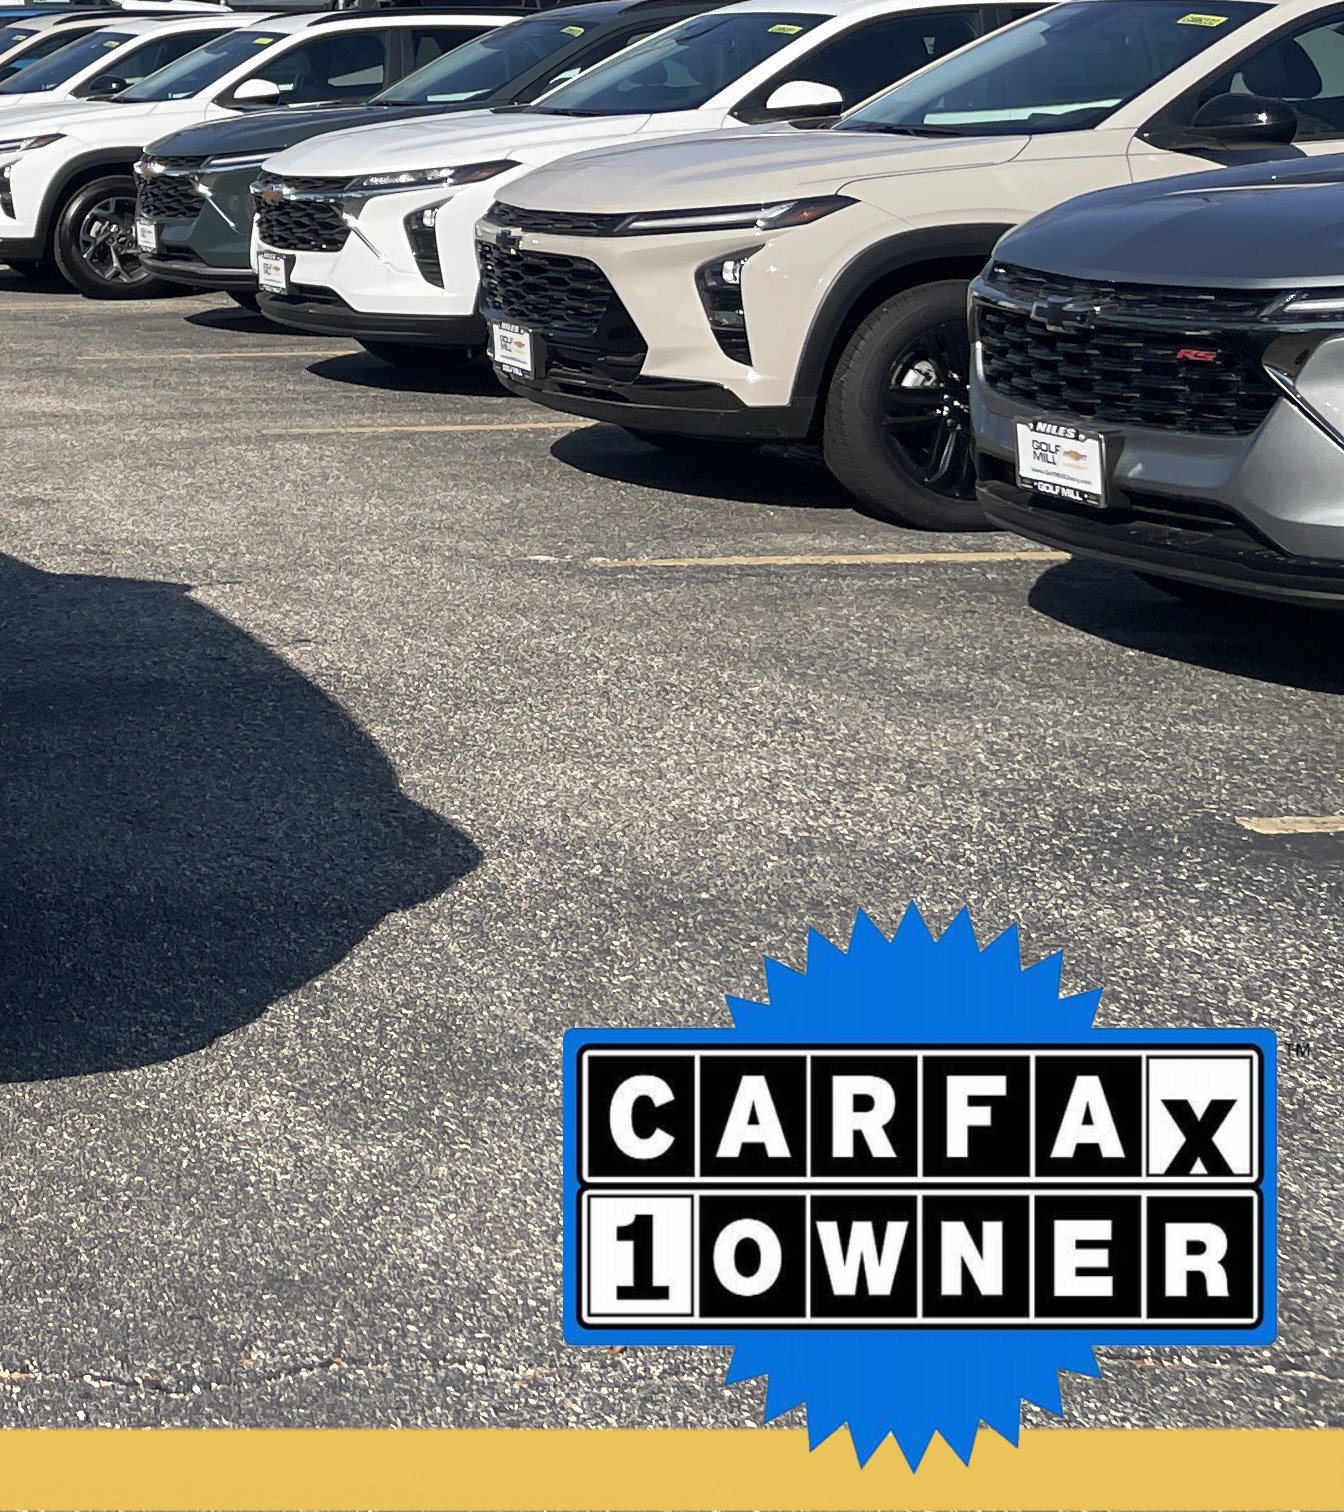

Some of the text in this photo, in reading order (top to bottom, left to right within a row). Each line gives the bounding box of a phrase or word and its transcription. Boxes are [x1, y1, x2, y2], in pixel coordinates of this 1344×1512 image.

[1176, 348, 1216, 361] RS
[1035, 421, 1077, 439] NILES
[1032, 439, 1061, 454] GOLF
